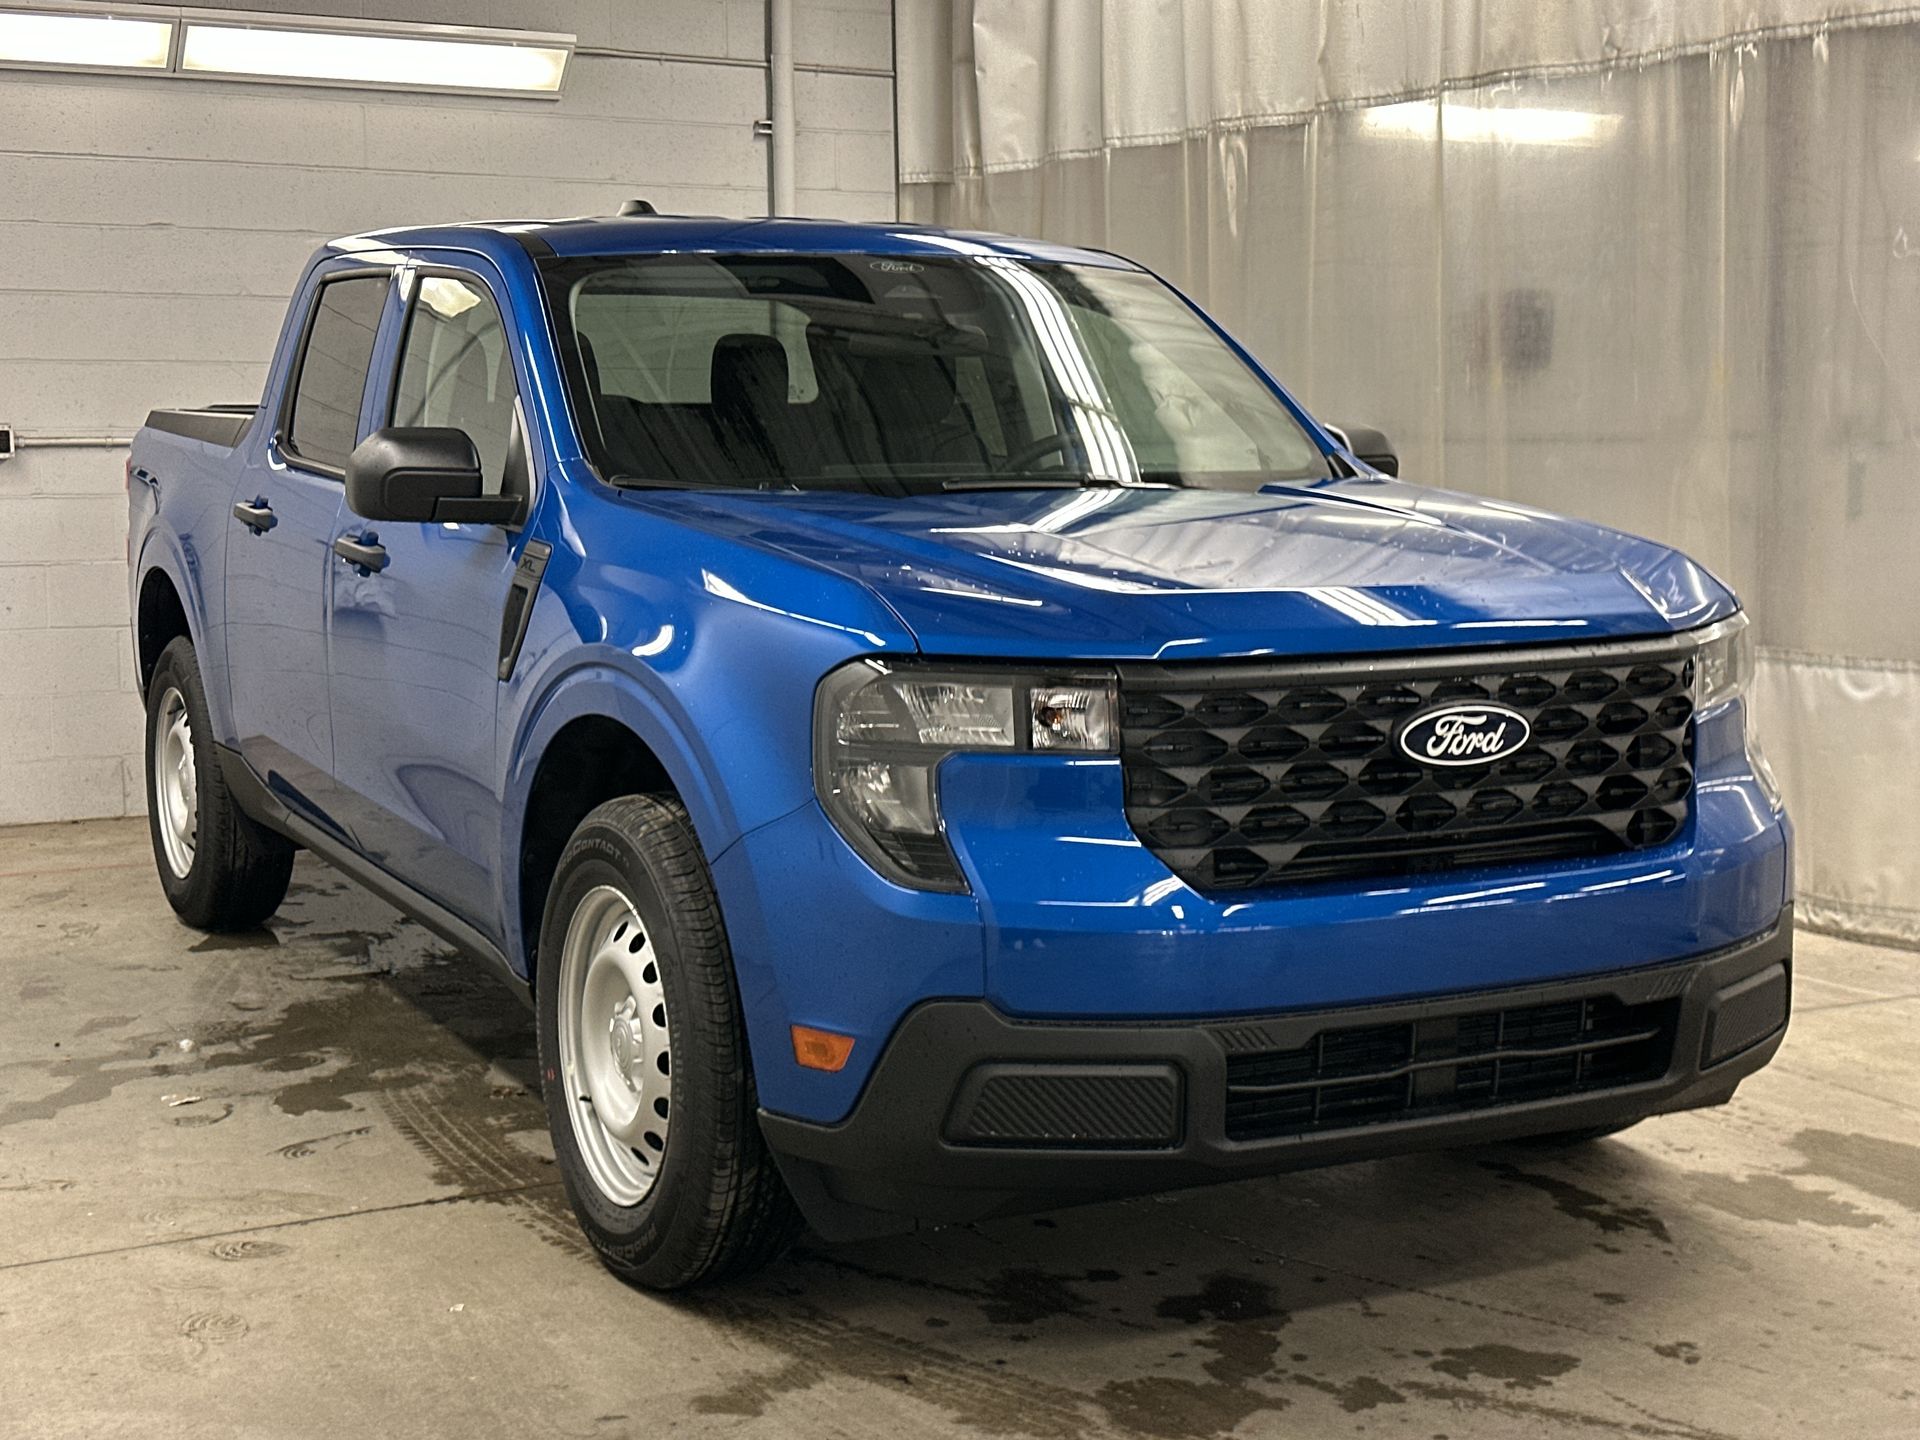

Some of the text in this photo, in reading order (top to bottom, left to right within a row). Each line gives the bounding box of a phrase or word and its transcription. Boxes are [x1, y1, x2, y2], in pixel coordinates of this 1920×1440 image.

[880, 261, 916, 272] Ford
[520, 557, 536, 574] XL
[1426, 714, 1507, 757] Ford
